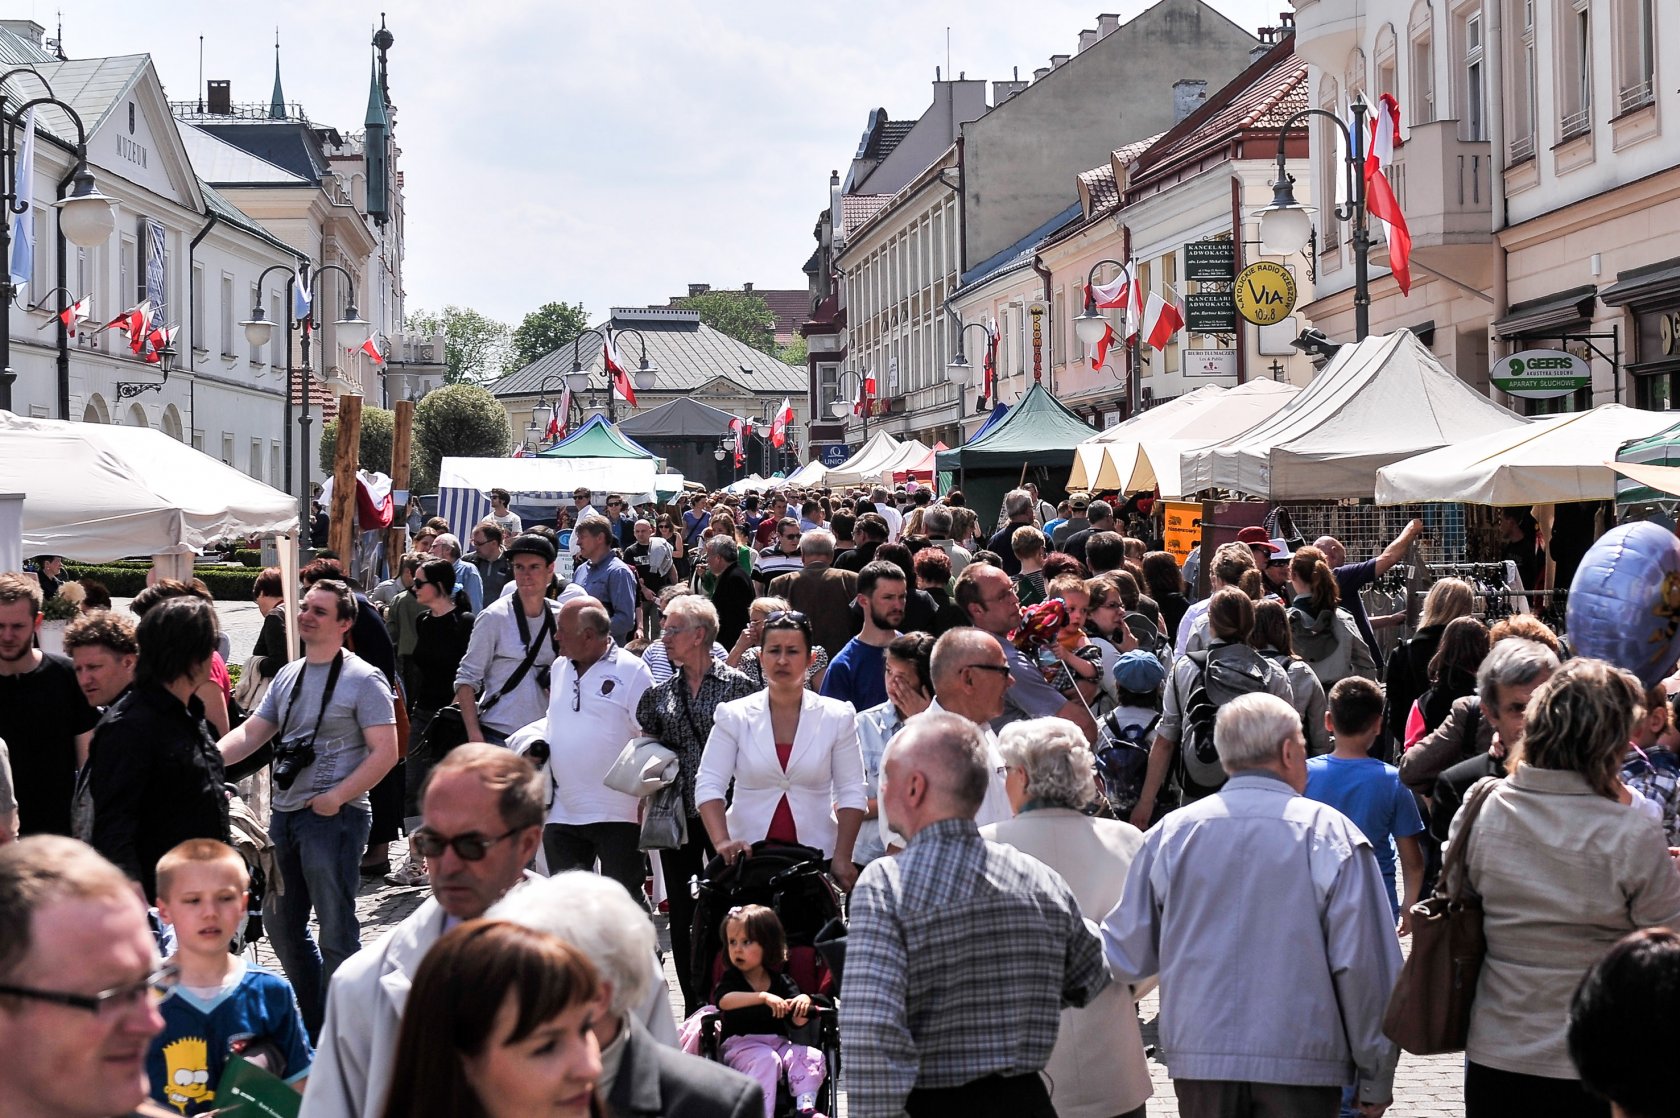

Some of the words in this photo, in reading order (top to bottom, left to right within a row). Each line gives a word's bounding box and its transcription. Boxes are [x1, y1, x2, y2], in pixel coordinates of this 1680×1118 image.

[116, 133, 147, 169] MUZEUM
[1257, 264, 1280, 274] RADIO
[1280, 272, 1294, 310] RZESZÓW
[1032, 314, 1042, 383] PROMENAD
[1526, 357, 1572, 369] GEERS
